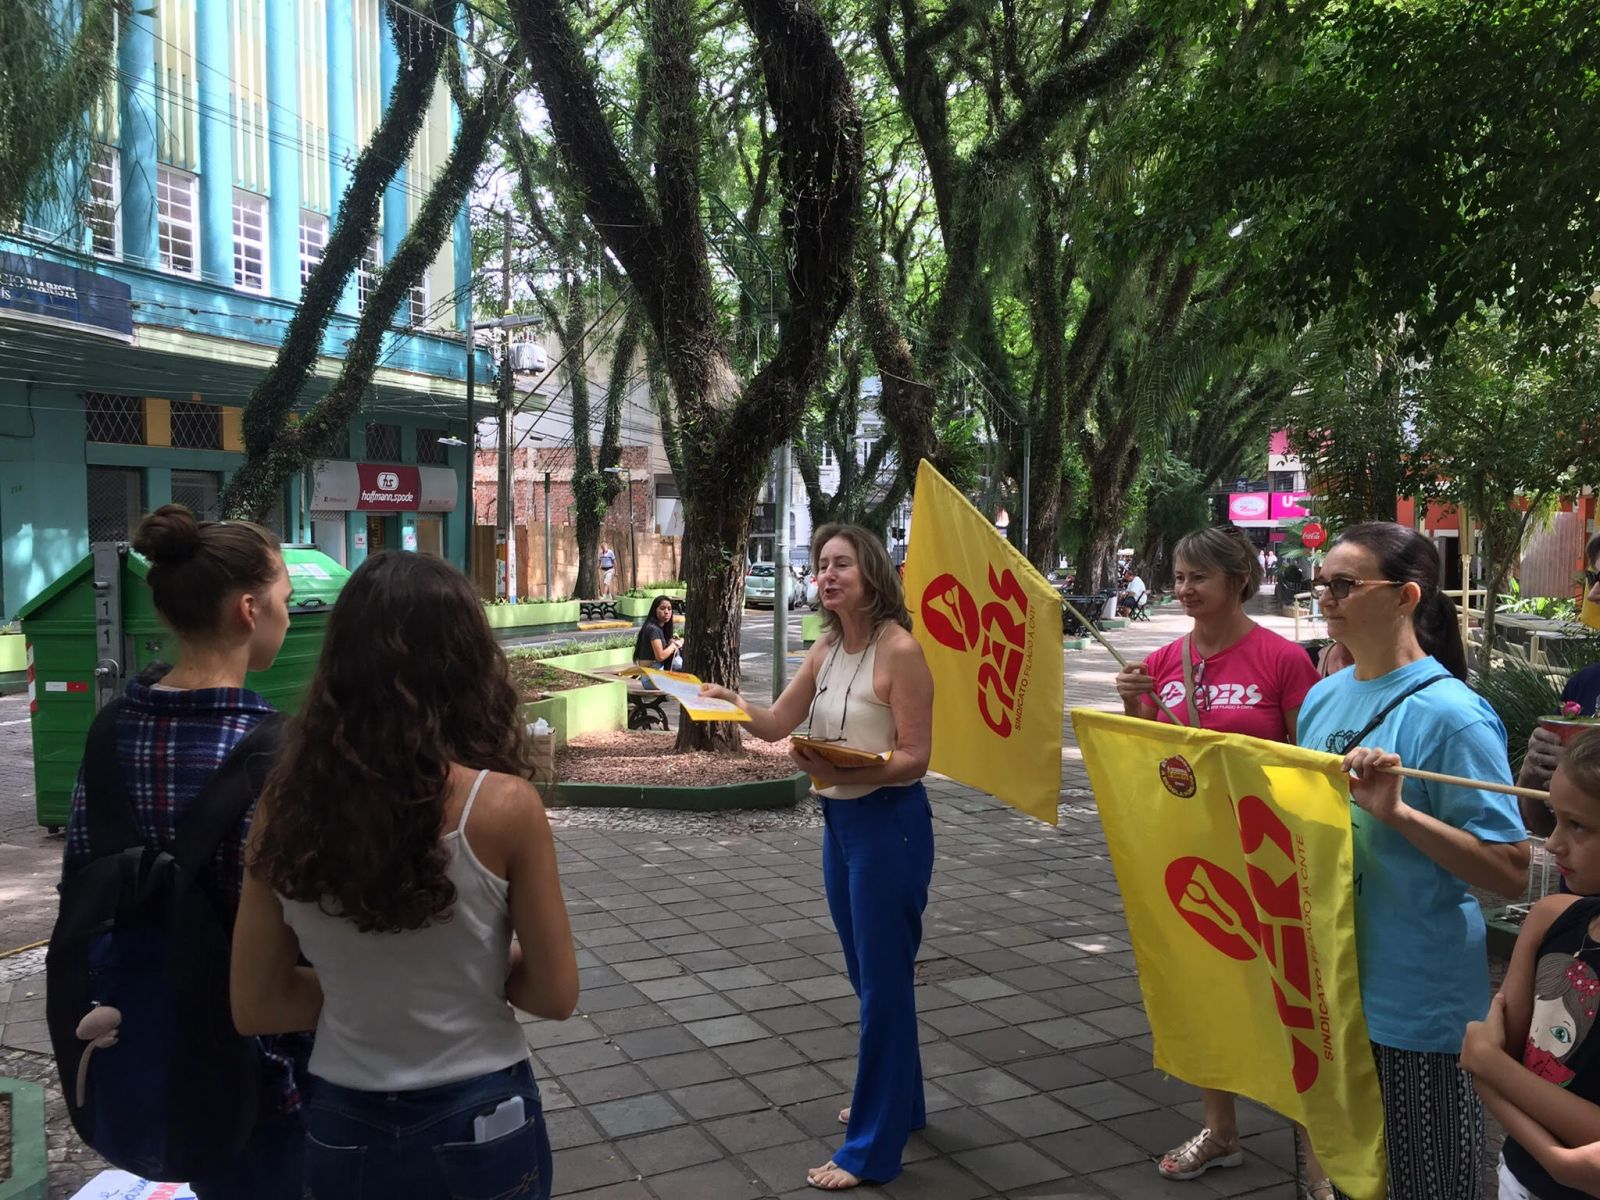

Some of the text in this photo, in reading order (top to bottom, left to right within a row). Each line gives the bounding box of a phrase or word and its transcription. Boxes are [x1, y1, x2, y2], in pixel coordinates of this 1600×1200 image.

[978, 561, 1028, 739] CPERS
[1014, 678, 1029, 731] SINDICATO
[1295, 832, 1309, 884] CNTE
[1314, 966, 1333, 1061] SINDICATO
